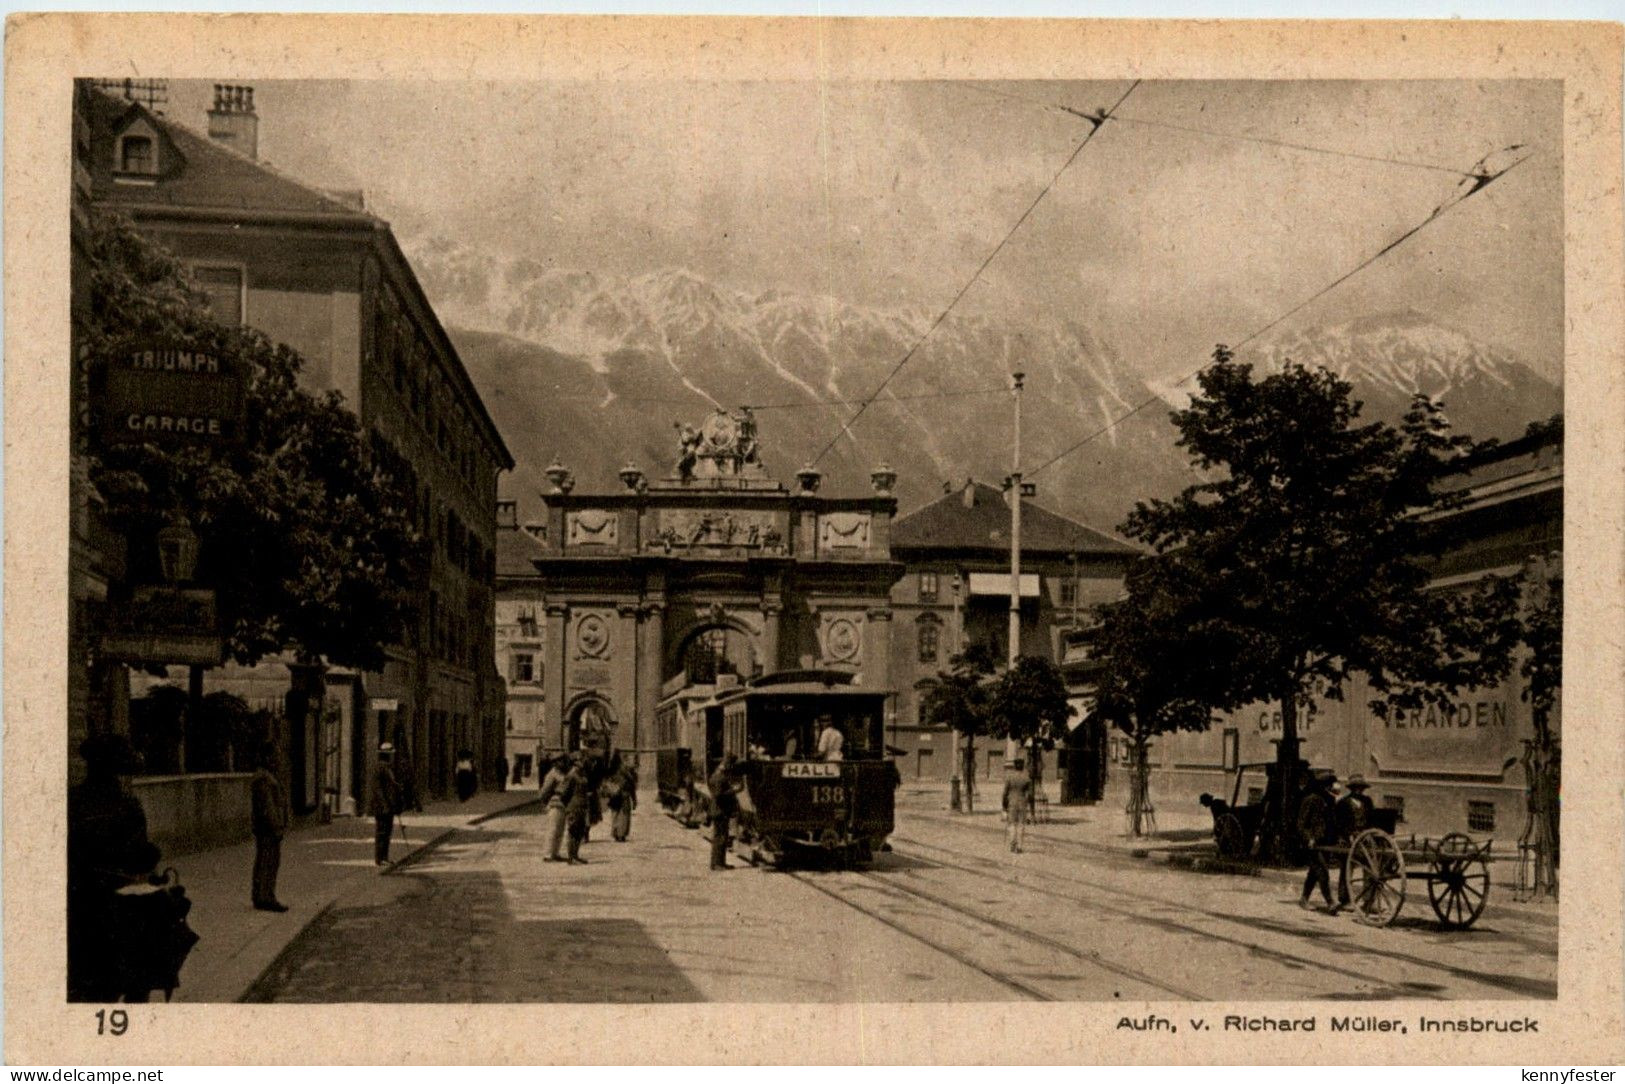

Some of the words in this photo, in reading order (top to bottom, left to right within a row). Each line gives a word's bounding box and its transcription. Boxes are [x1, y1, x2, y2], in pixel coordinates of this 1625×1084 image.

[131, 350, 219, 373] TRIUMPH
[127, 414, 222, 435] GARAGE
[788, 765, 836, 777] HALL
[811, 786, 845, 804] 138
[95, 1009, 129, 1036] 19
[1190, 1018, 1210, 1031] v.
[1224, 1015, 1316, 1031] Richard
[1330, 1016, 1408, 1034] Müller,
[1420, 1016, 1539, 1032] Innsbruck
